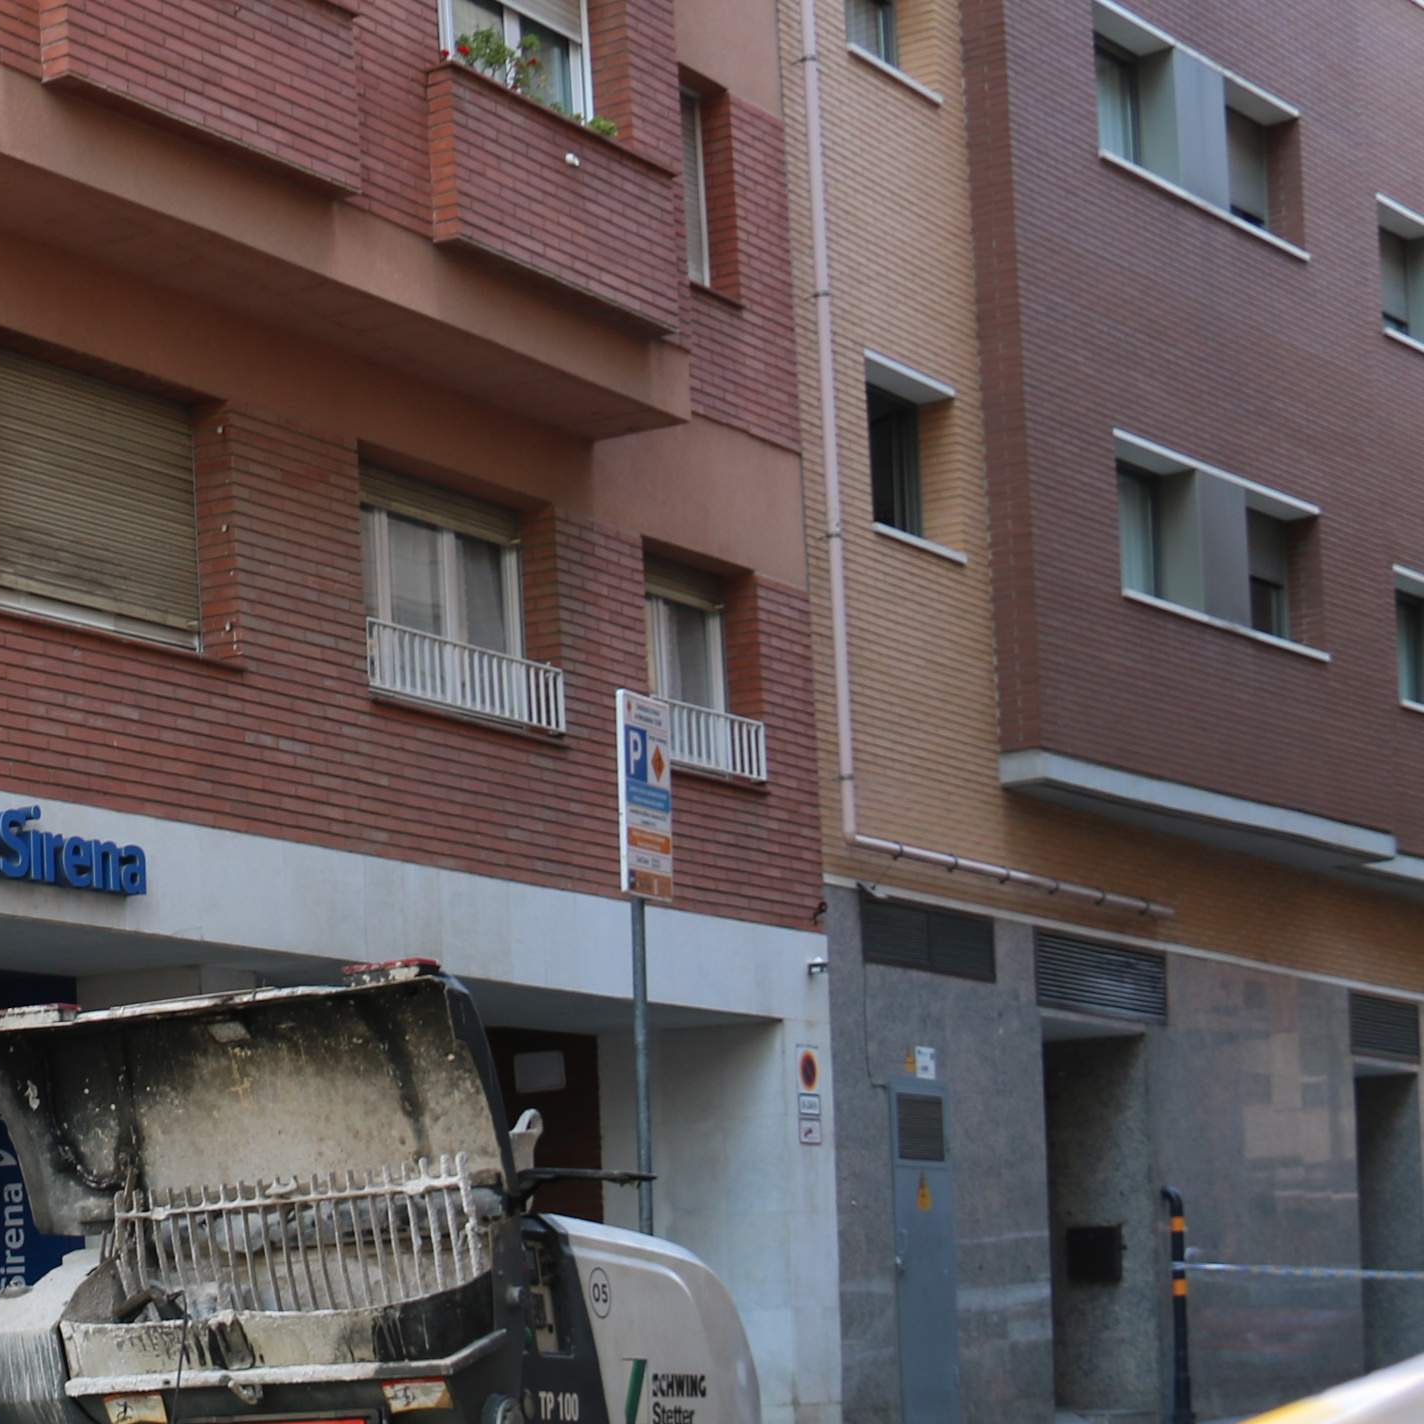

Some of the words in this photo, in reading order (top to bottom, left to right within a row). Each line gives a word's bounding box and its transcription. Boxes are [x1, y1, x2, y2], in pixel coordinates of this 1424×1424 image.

[628, 730, 643, 775] P
[592, 1283, 609, 1304] 05
[539, 1390, 555, 1421] TP
[558, 1391, 580, 1423] 100
